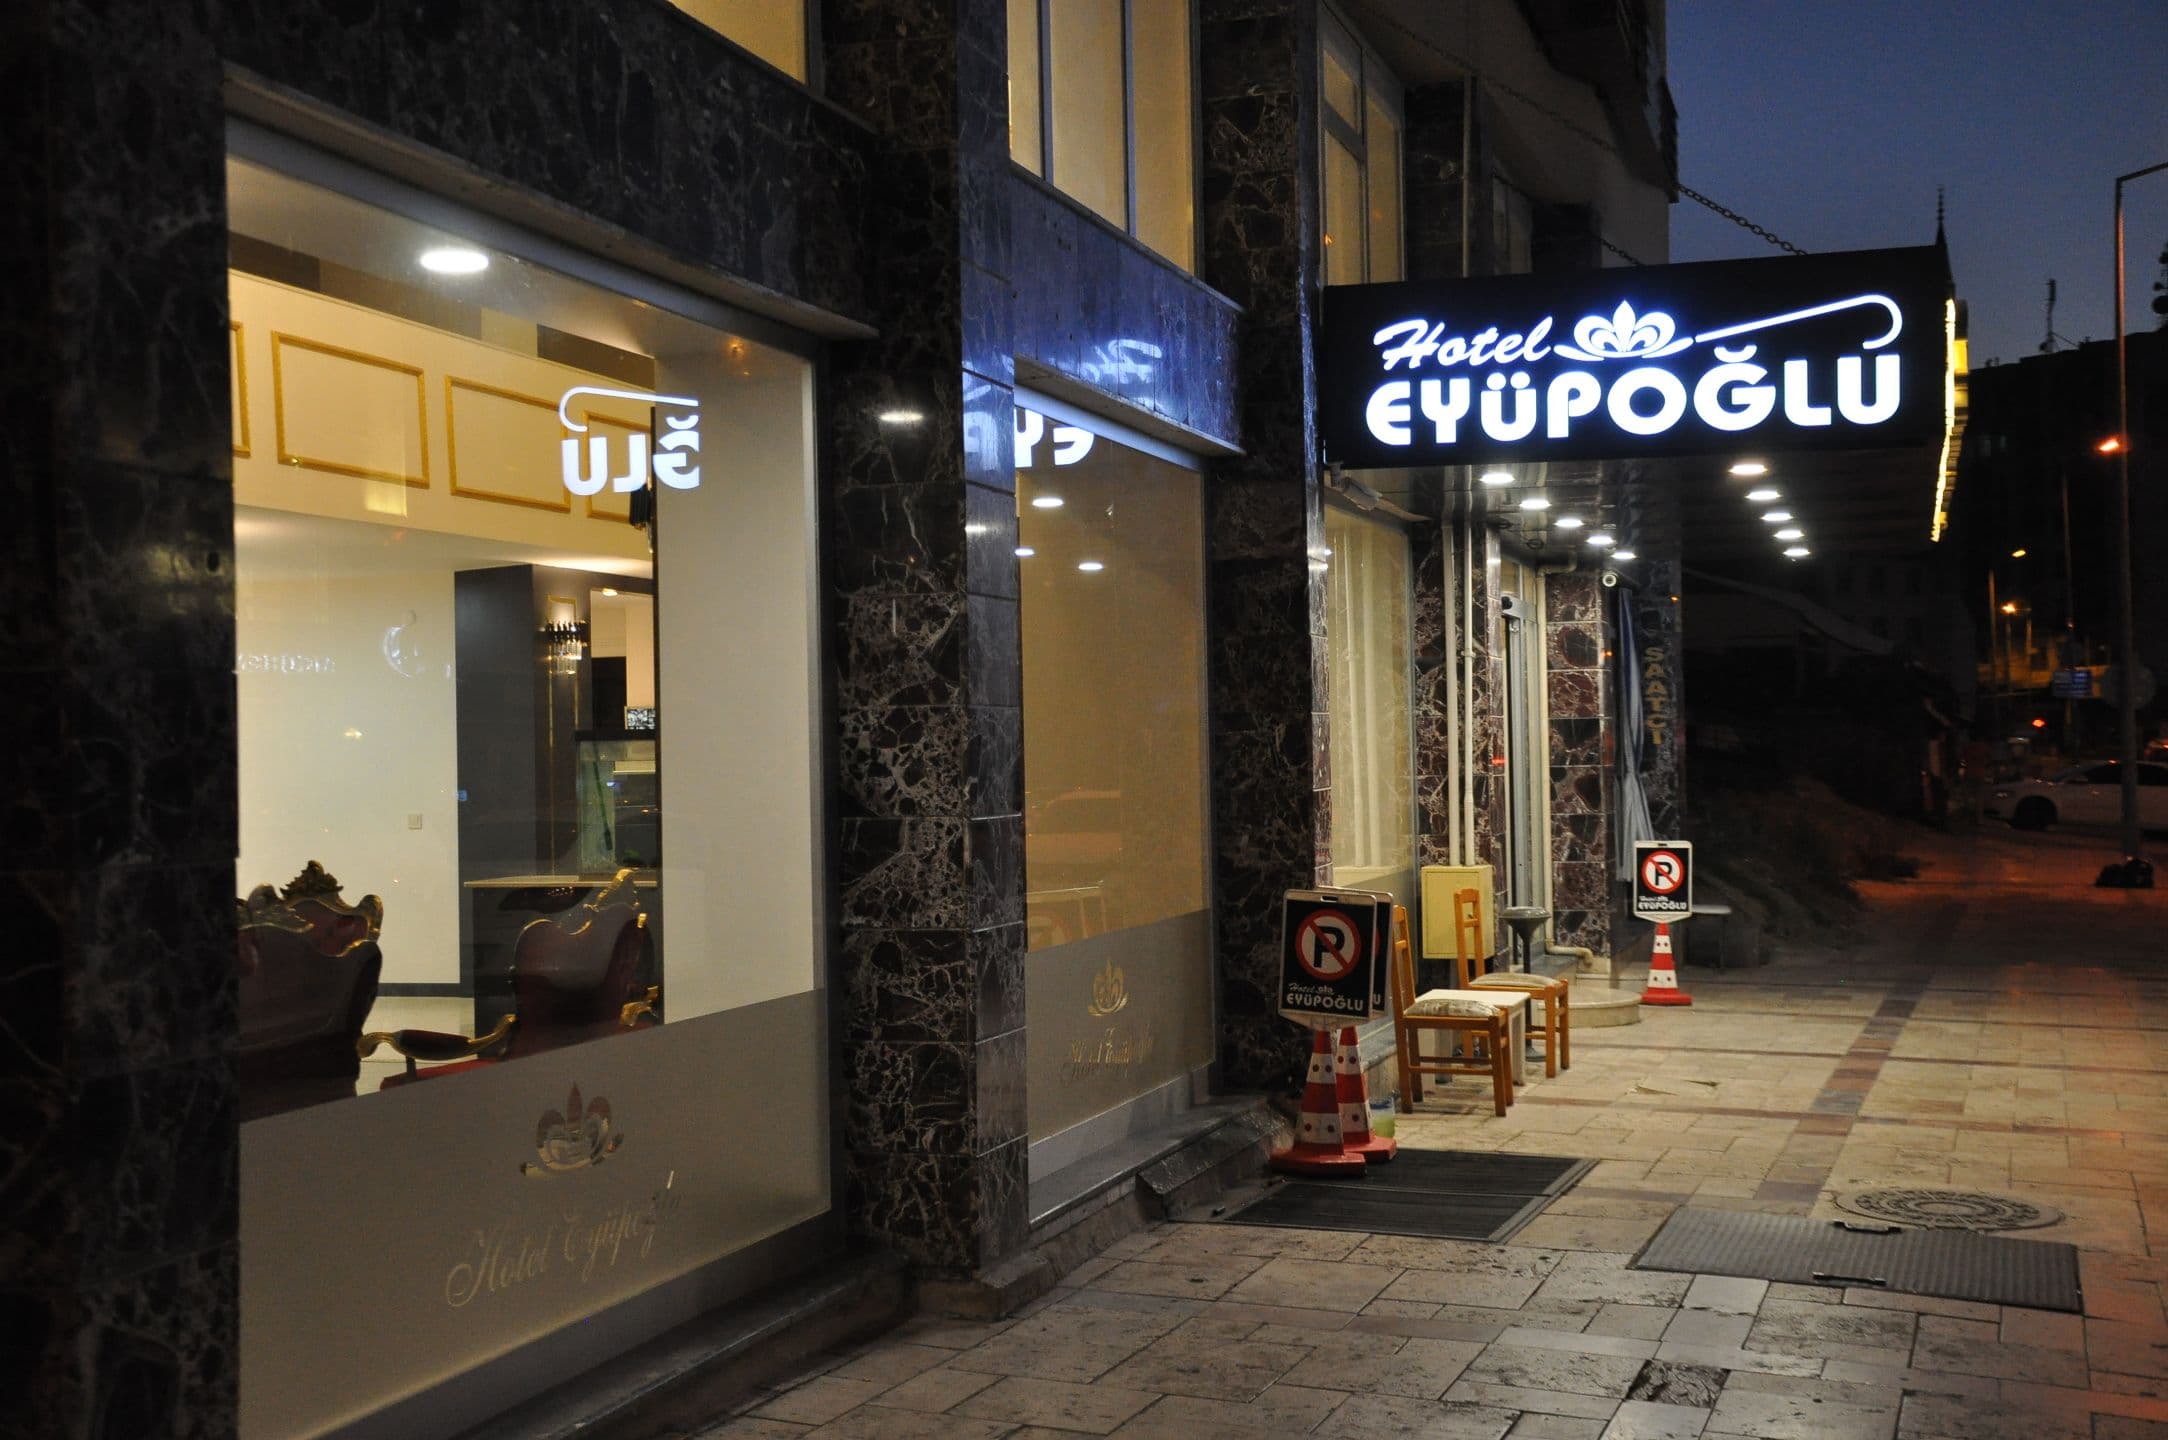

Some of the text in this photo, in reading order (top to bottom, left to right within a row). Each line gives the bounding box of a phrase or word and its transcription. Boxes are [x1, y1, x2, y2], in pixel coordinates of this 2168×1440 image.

[1373, 316, 1554, 371] Hotel
[1366, 345, 1901, 446] EYÜPOĞLU
[1286, 993, 1364, 1012] EYÜPOĞLU
